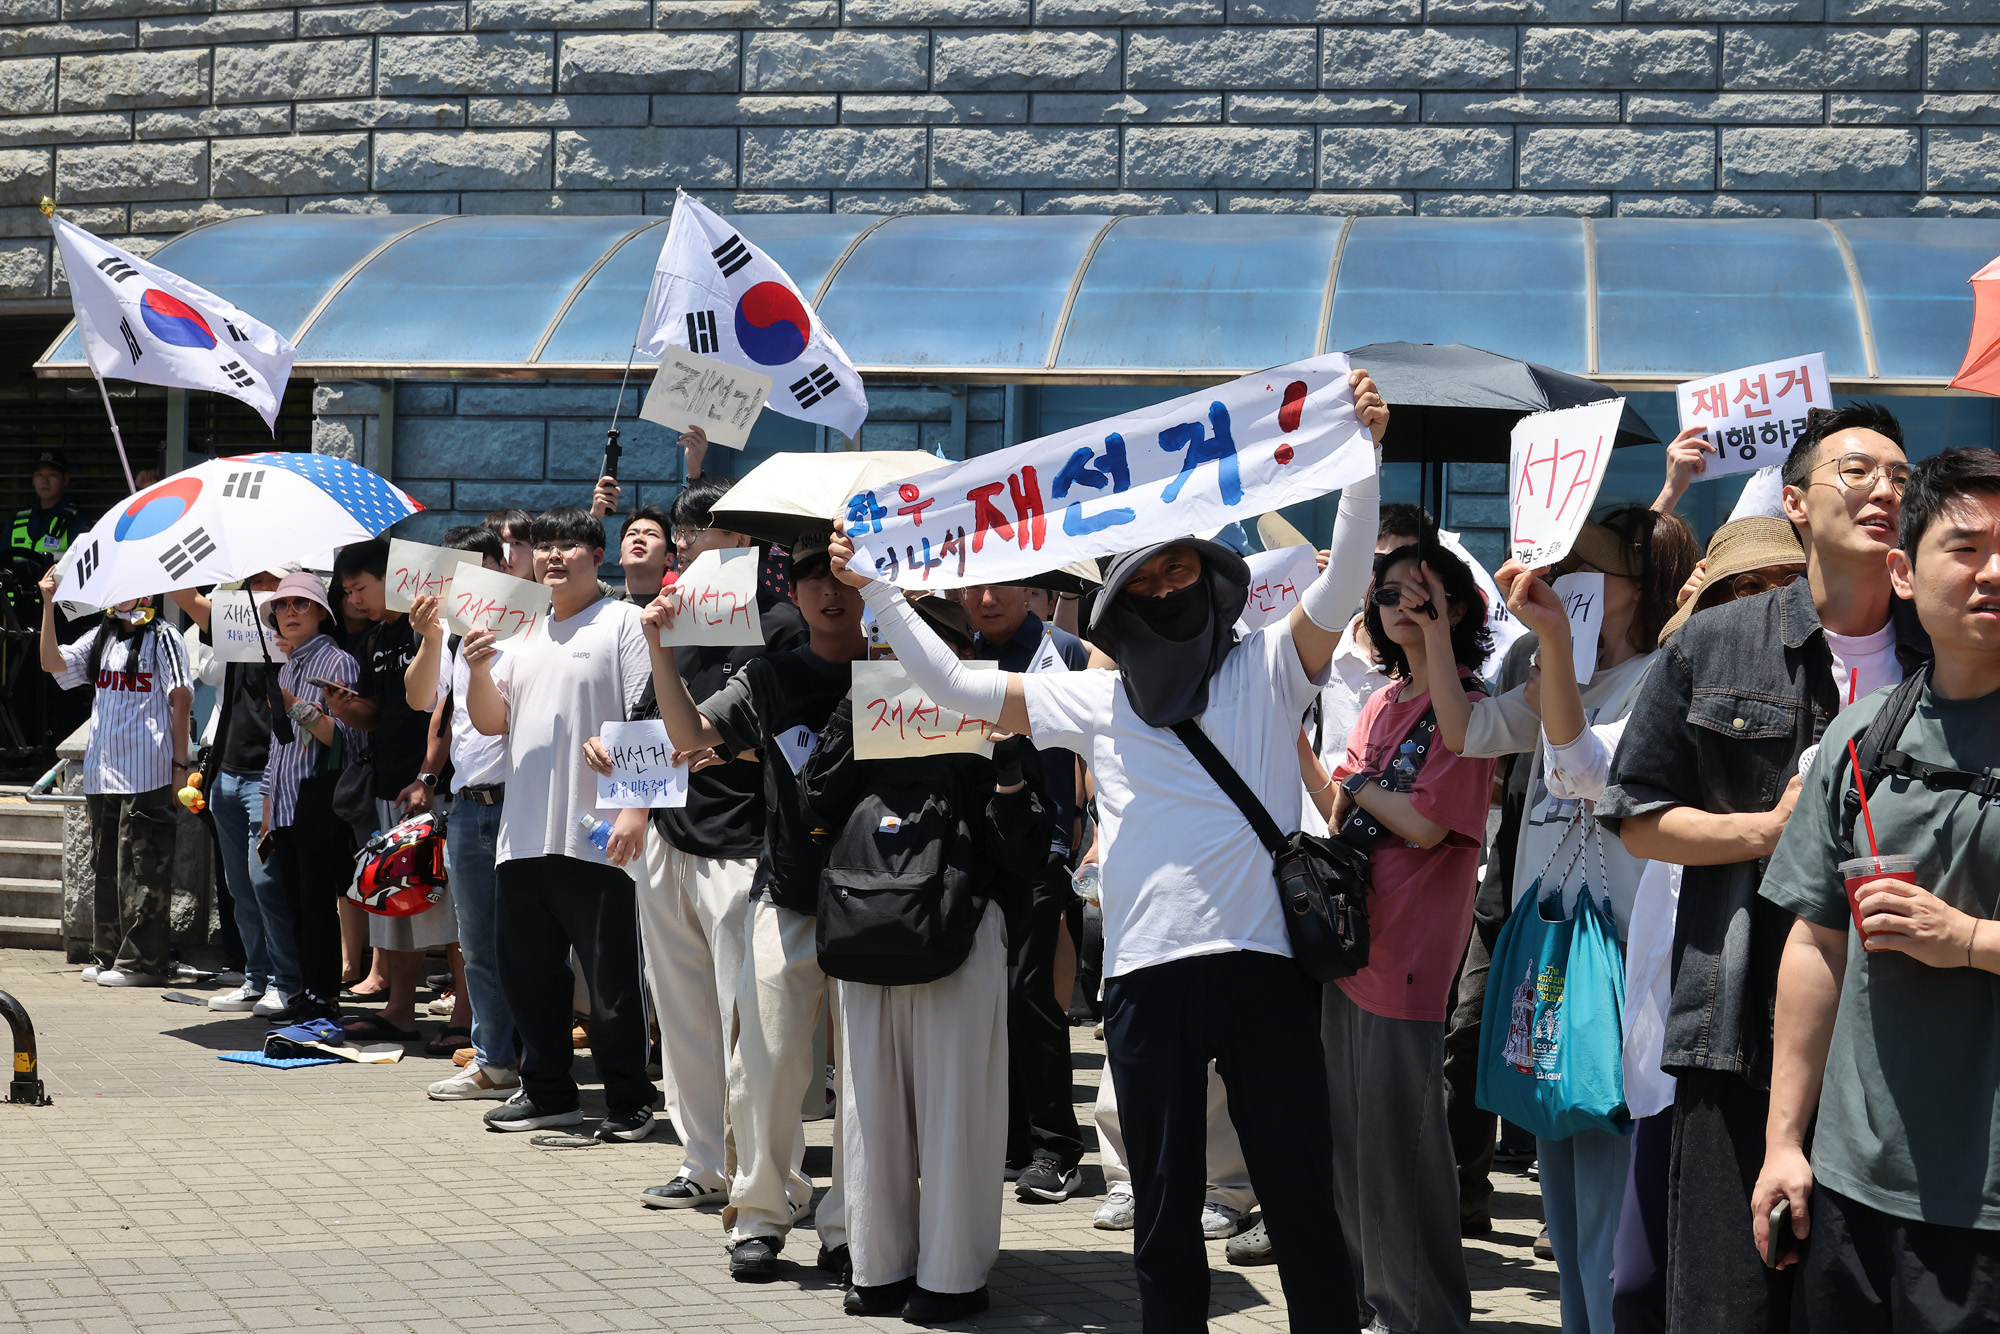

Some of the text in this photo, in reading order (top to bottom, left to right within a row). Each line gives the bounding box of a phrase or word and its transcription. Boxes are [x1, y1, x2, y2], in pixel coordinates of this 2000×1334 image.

[666, 361, 763, 430] 재선거
[1691, 366, 1813, 419] 재선거
[1511, 435, 1603, 544] 선거
[395, 567, 453, 600] 재선
[1246, 577, 1300, 612] 선거
[222, 604, 258, 627] 재선
[456, 592, 537, 643] 재선거
[671, 584, 751, 630] 재선거
[226, 629, 243, 641] 자유
[1538, 973, 1565, 983] amazin
